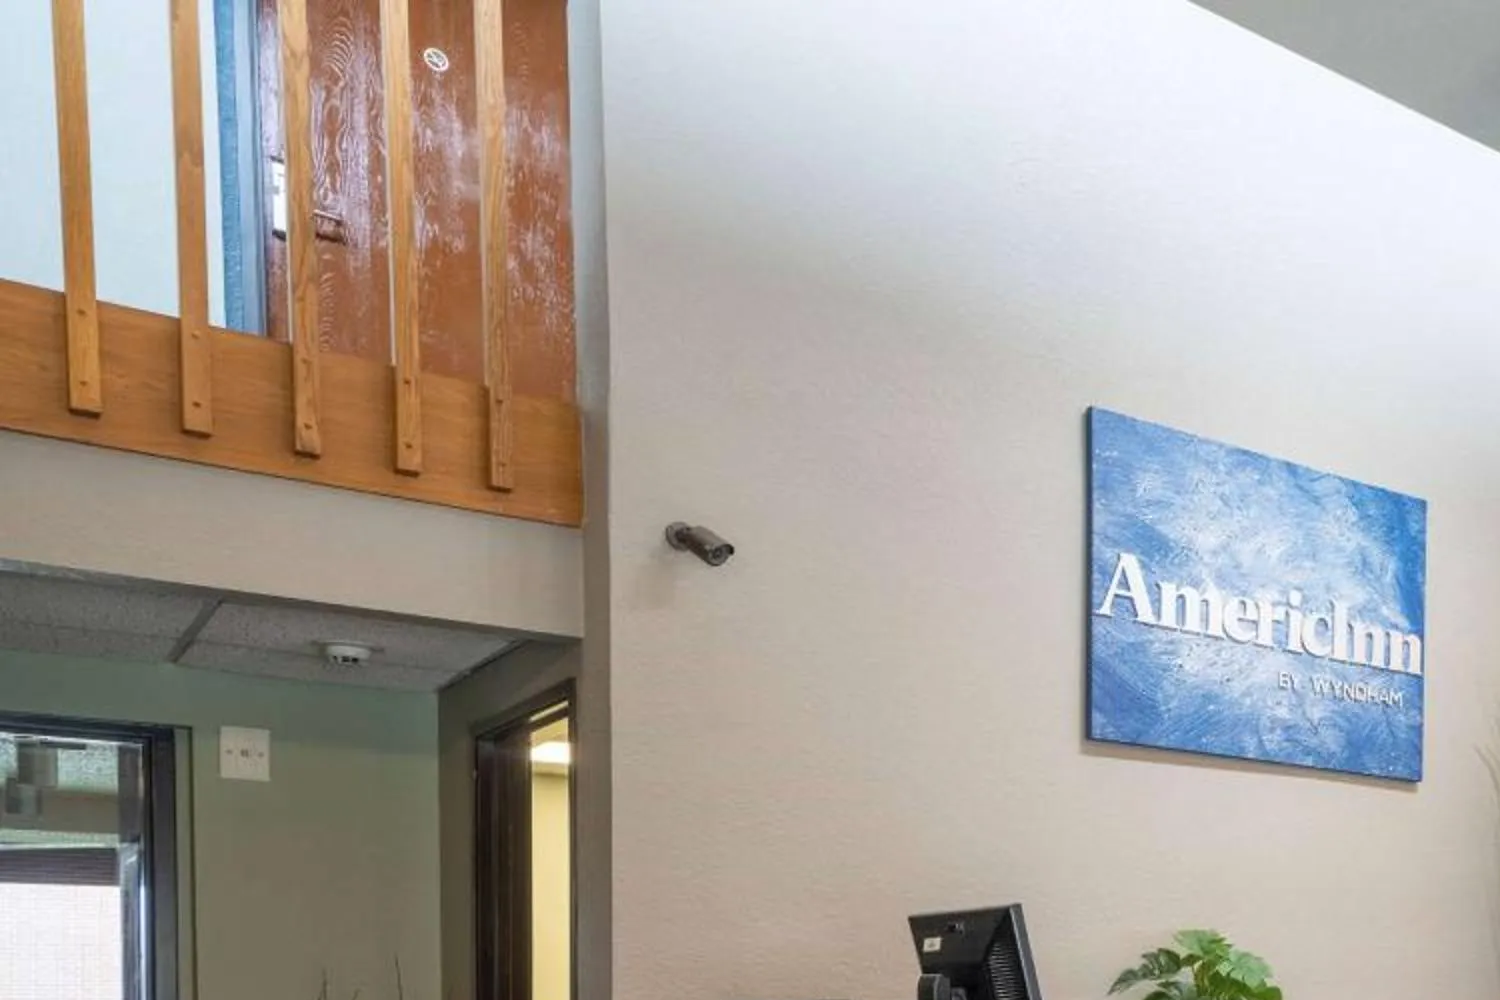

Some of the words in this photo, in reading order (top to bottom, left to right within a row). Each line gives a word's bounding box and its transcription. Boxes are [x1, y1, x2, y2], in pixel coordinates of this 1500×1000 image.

[1093, 552, 1423, 675] AmericInn
[1278, 671, 1299, 690] BY
[1310, 673, 1404, 706] WYNDHAM
